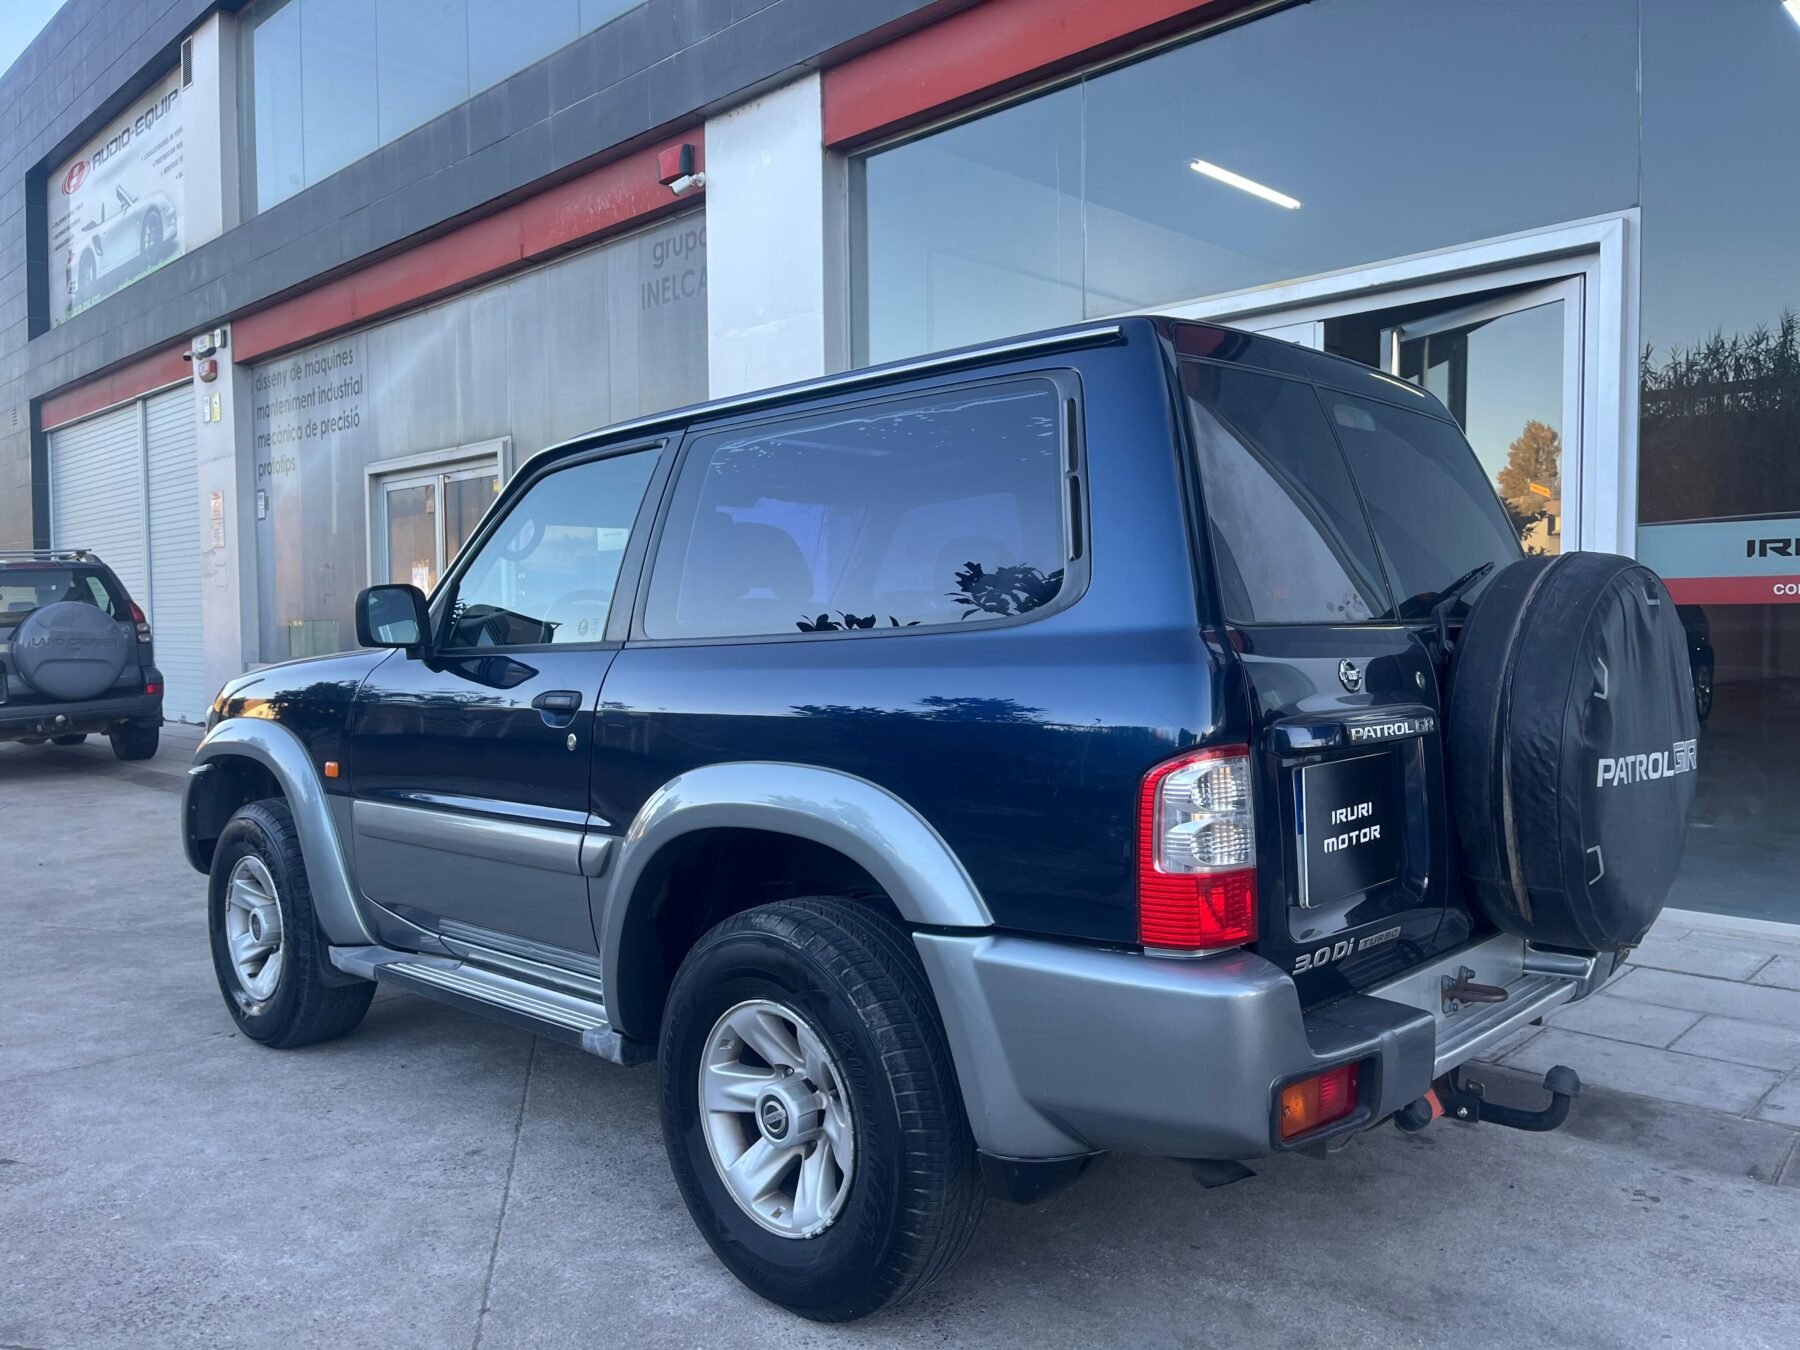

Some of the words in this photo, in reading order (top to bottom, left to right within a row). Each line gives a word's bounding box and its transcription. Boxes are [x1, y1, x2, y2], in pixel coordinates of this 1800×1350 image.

[92, 88, 179, 171] AUDIO-EQUIP
[255, 369, 288, 392] disseny
[290, 361, 302, 381] de
[305, 349, 354, 378] màquines
[257, 386, 316, 420] manteniment
[318, 373, 363, 405] industrial
[305, 418, 317, 439] de
[320, 404, 360, 440] precisió
[258, 454, 296, 481] prototips
[1747, 538, 1800, 558] IR
[1773, 583, 1800, 595] CO
[1351, 722, 1414, 741] PATROL
[1597, 751, 1675, 788] PATROL
[1332, 801, 1373, 825] IRURI
[1324, 824, 1381, 854] MOTOR
[1363, 929, 1400, 948] TURBO
